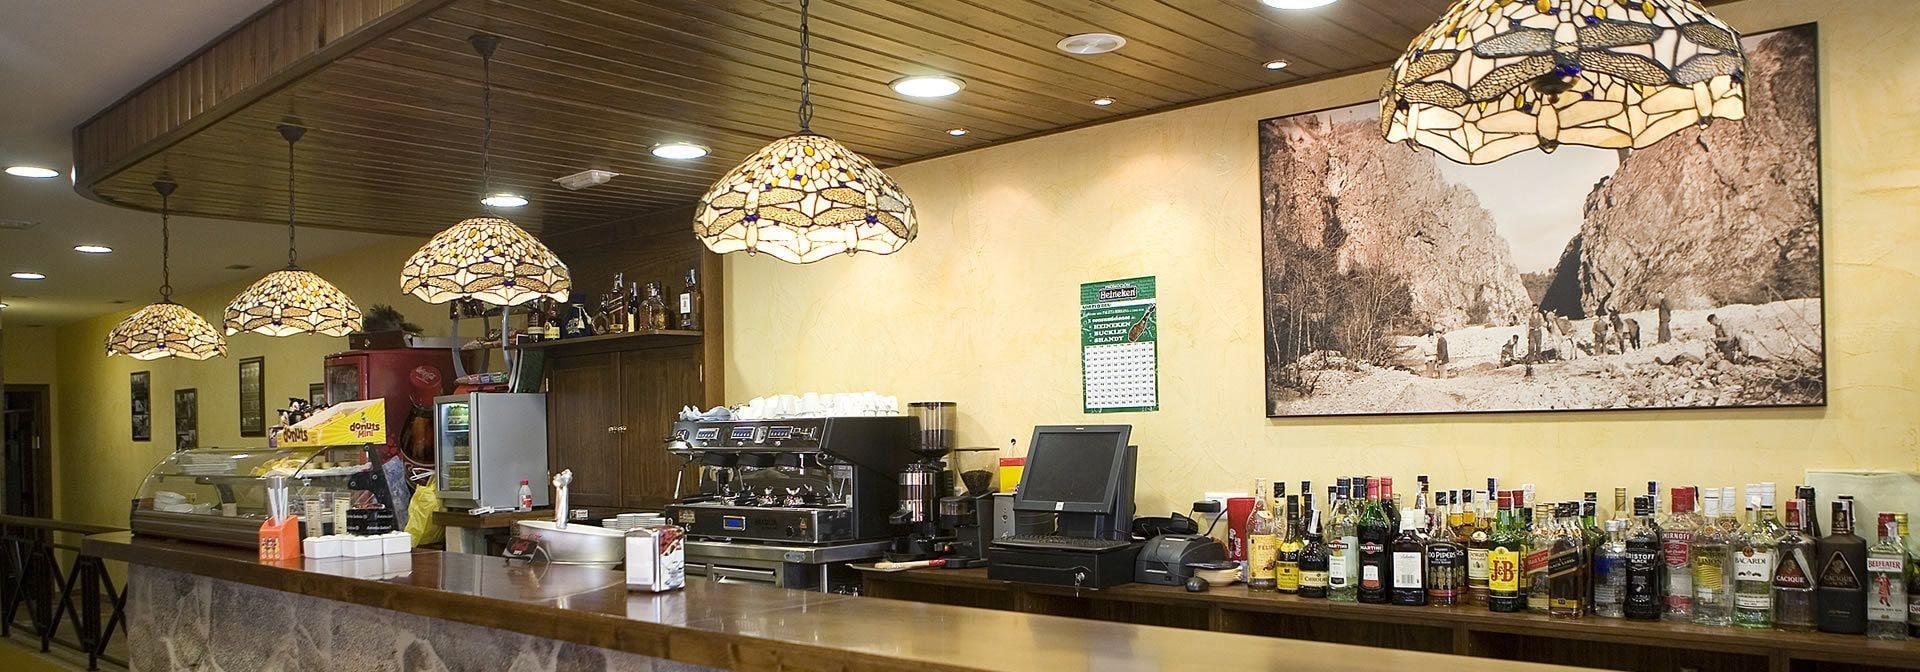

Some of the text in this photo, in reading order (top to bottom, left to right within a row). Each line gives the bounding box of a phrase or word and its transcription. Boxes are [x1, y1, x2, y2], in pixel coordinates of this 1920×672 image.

[1100, 288, 1136, 300] Heineken
[349, 422, 380, 432] donuts
[283, 427, 308, 443] donuts
[1435, 551, 1456, 559] PIPERS
[1735, 557, 1766, 565] BACARDI
[1868, 560, 1901, 569] BEEFEATER
[1491, 560, 1514, 582] J&B
[1776, 575, 1805, 583] CACIQUE
